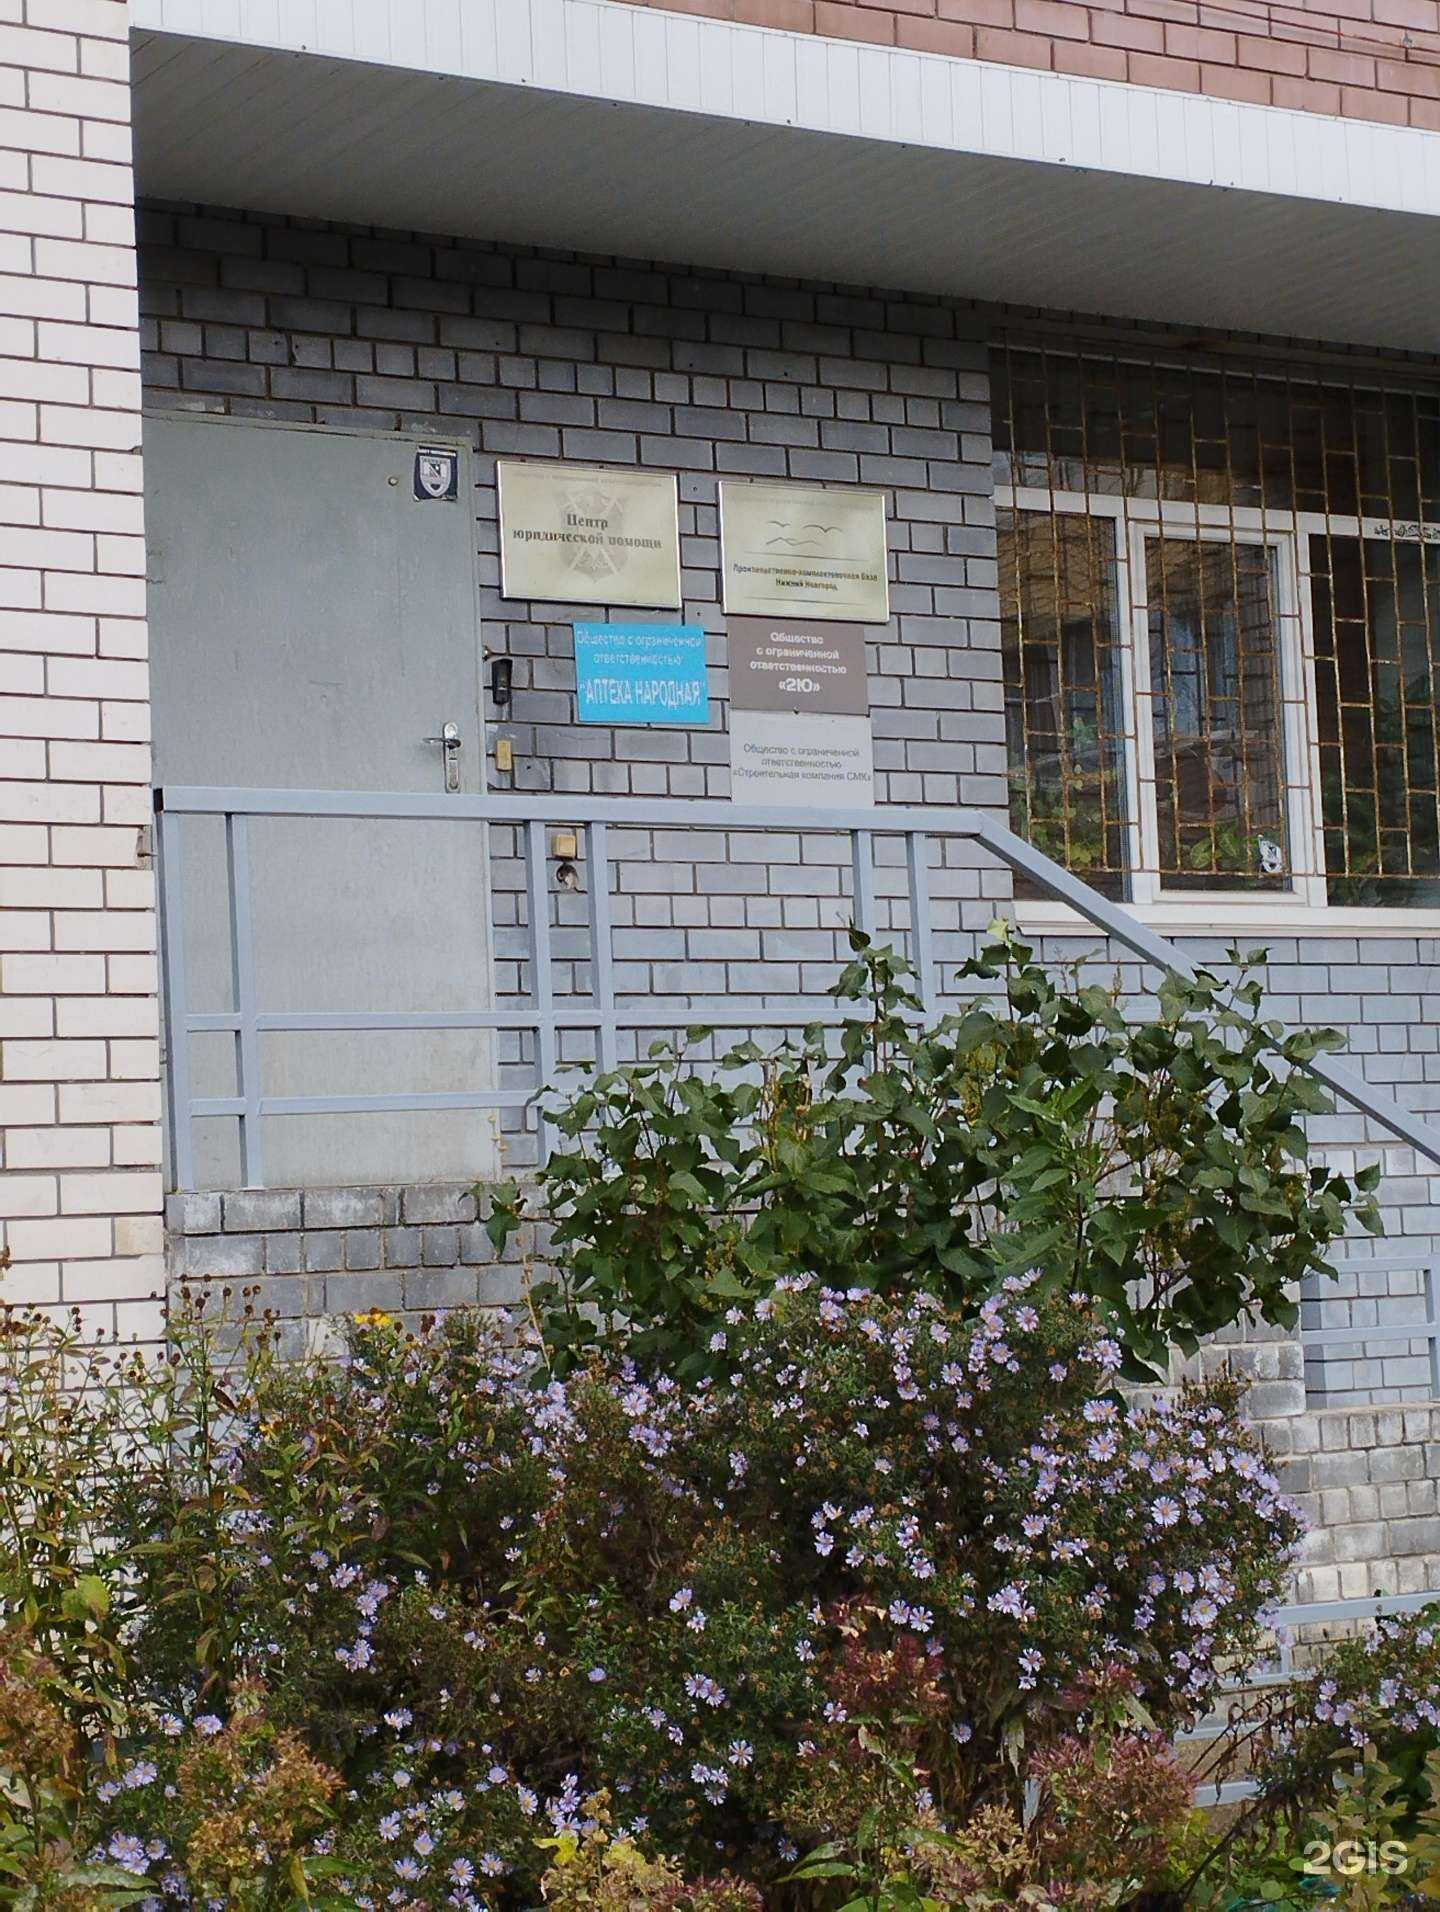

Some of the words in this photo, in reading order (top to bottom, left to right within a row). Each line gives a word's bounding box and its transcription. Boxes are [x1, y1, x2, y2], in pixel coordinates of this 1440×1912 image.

[567, 513, 608, 529] Центр
[513, 528, 603, 545] юридической
[608, 536, 662, 549] помощи
[770, 631, 824, 644] Общество
[756, 647, 763, 655] с
[750, 661, 847, 674] ответственностью
[743, 743, 789, 754] Общество
[761, 758, 842, 769] ответственностью
